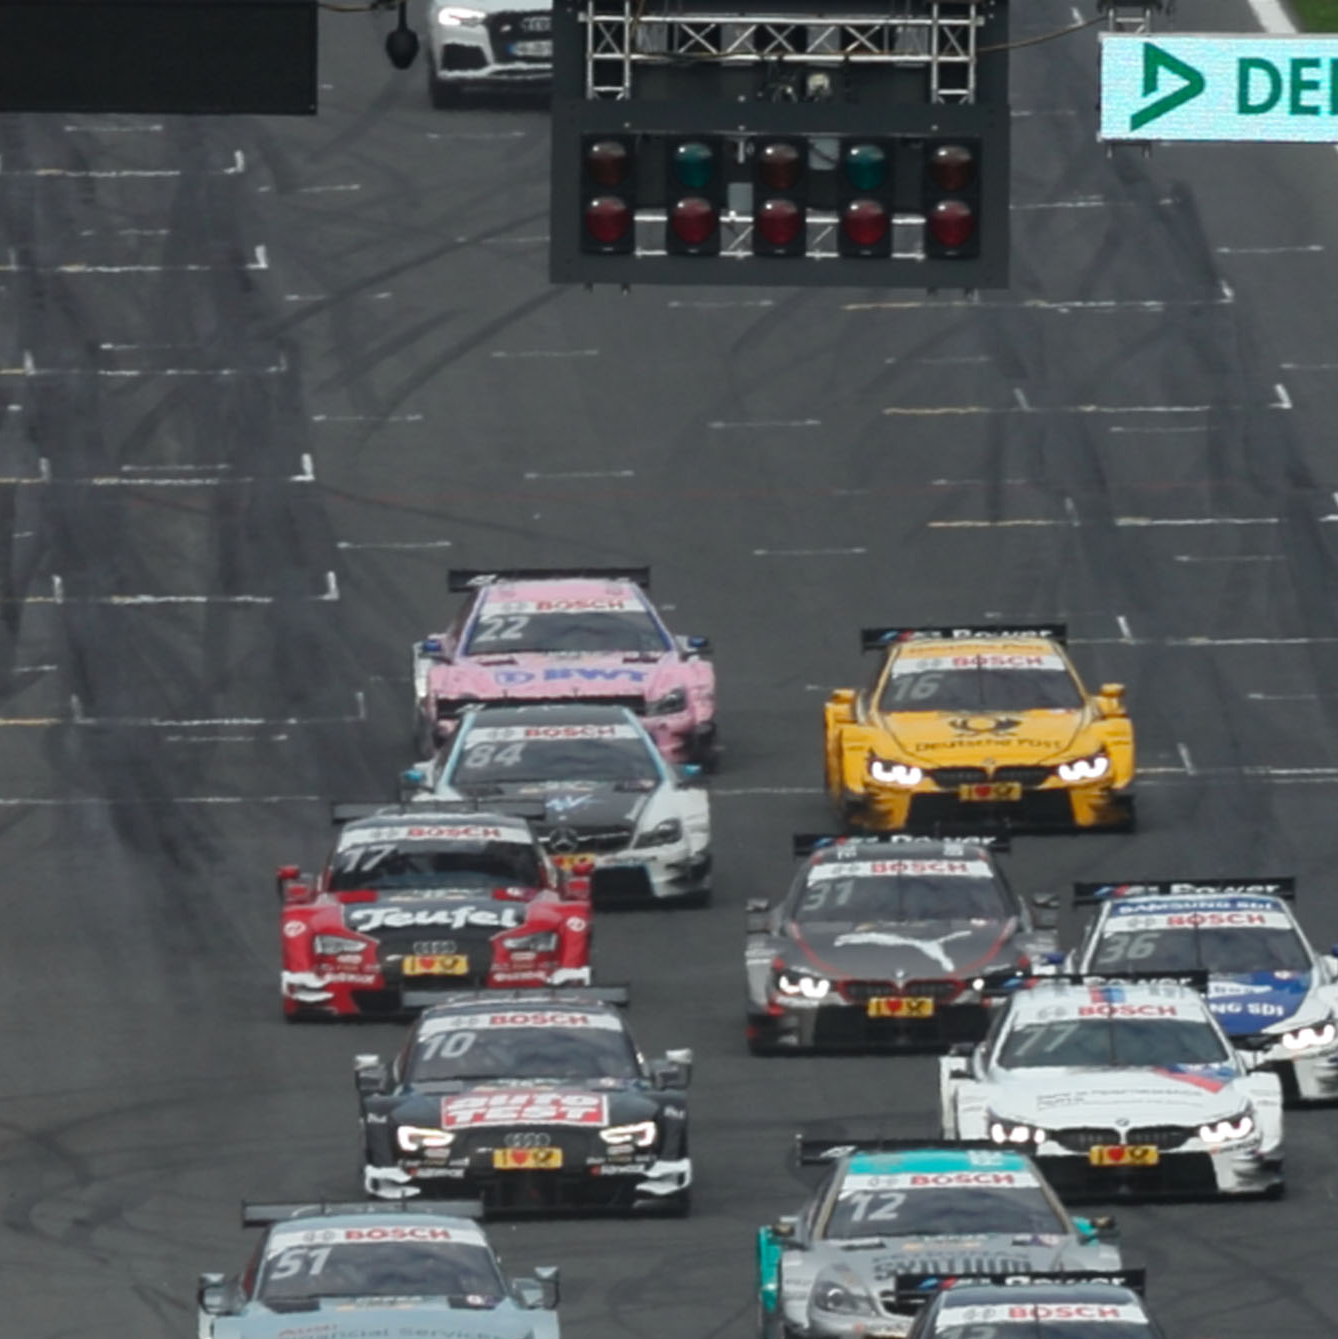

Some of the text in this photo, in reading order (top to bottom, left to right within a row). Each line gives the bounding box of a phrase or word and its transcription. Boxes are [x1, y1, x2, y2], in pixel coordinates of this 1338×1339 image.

[535, 600, 625, 611] BOSCH
[475, 615, 530, 643] 22
[952, 656, 1043, 667] BOSCH
[543, 668, 649, 682] BWT
[893, 674, 944, 701] 16
[524, 726, 616, 738] BOSCH
[464, 743, 526, 767] 84
[406, 827, 501, 838] BOSCH
[341, 844, 397, 872] 17
[870, 862, 968, 873] BOSCH
[802, 880, 855, 911] 31
[349, 905, 520, 932] Teufel
[1167, 914, 1266, 926] BOSCH
[1096, 933, 1161, 963] 36
[1077, 1004, 1177, 1016] BOSCH
[488, 1014, 588, 1026] BOSCH
[422, 1031, 478, 1061] 10
[1016, 1024, 1081, 1056] 77
[910, 1174, 1015, 1186] BOSCH
[848, 1193, 906, 1222] 12
[344, 1229, 451, 1241] BOSCH
[270, 1247, 333, 1280] 51
[1007, 1306, 1120, 1319] BOSCH
